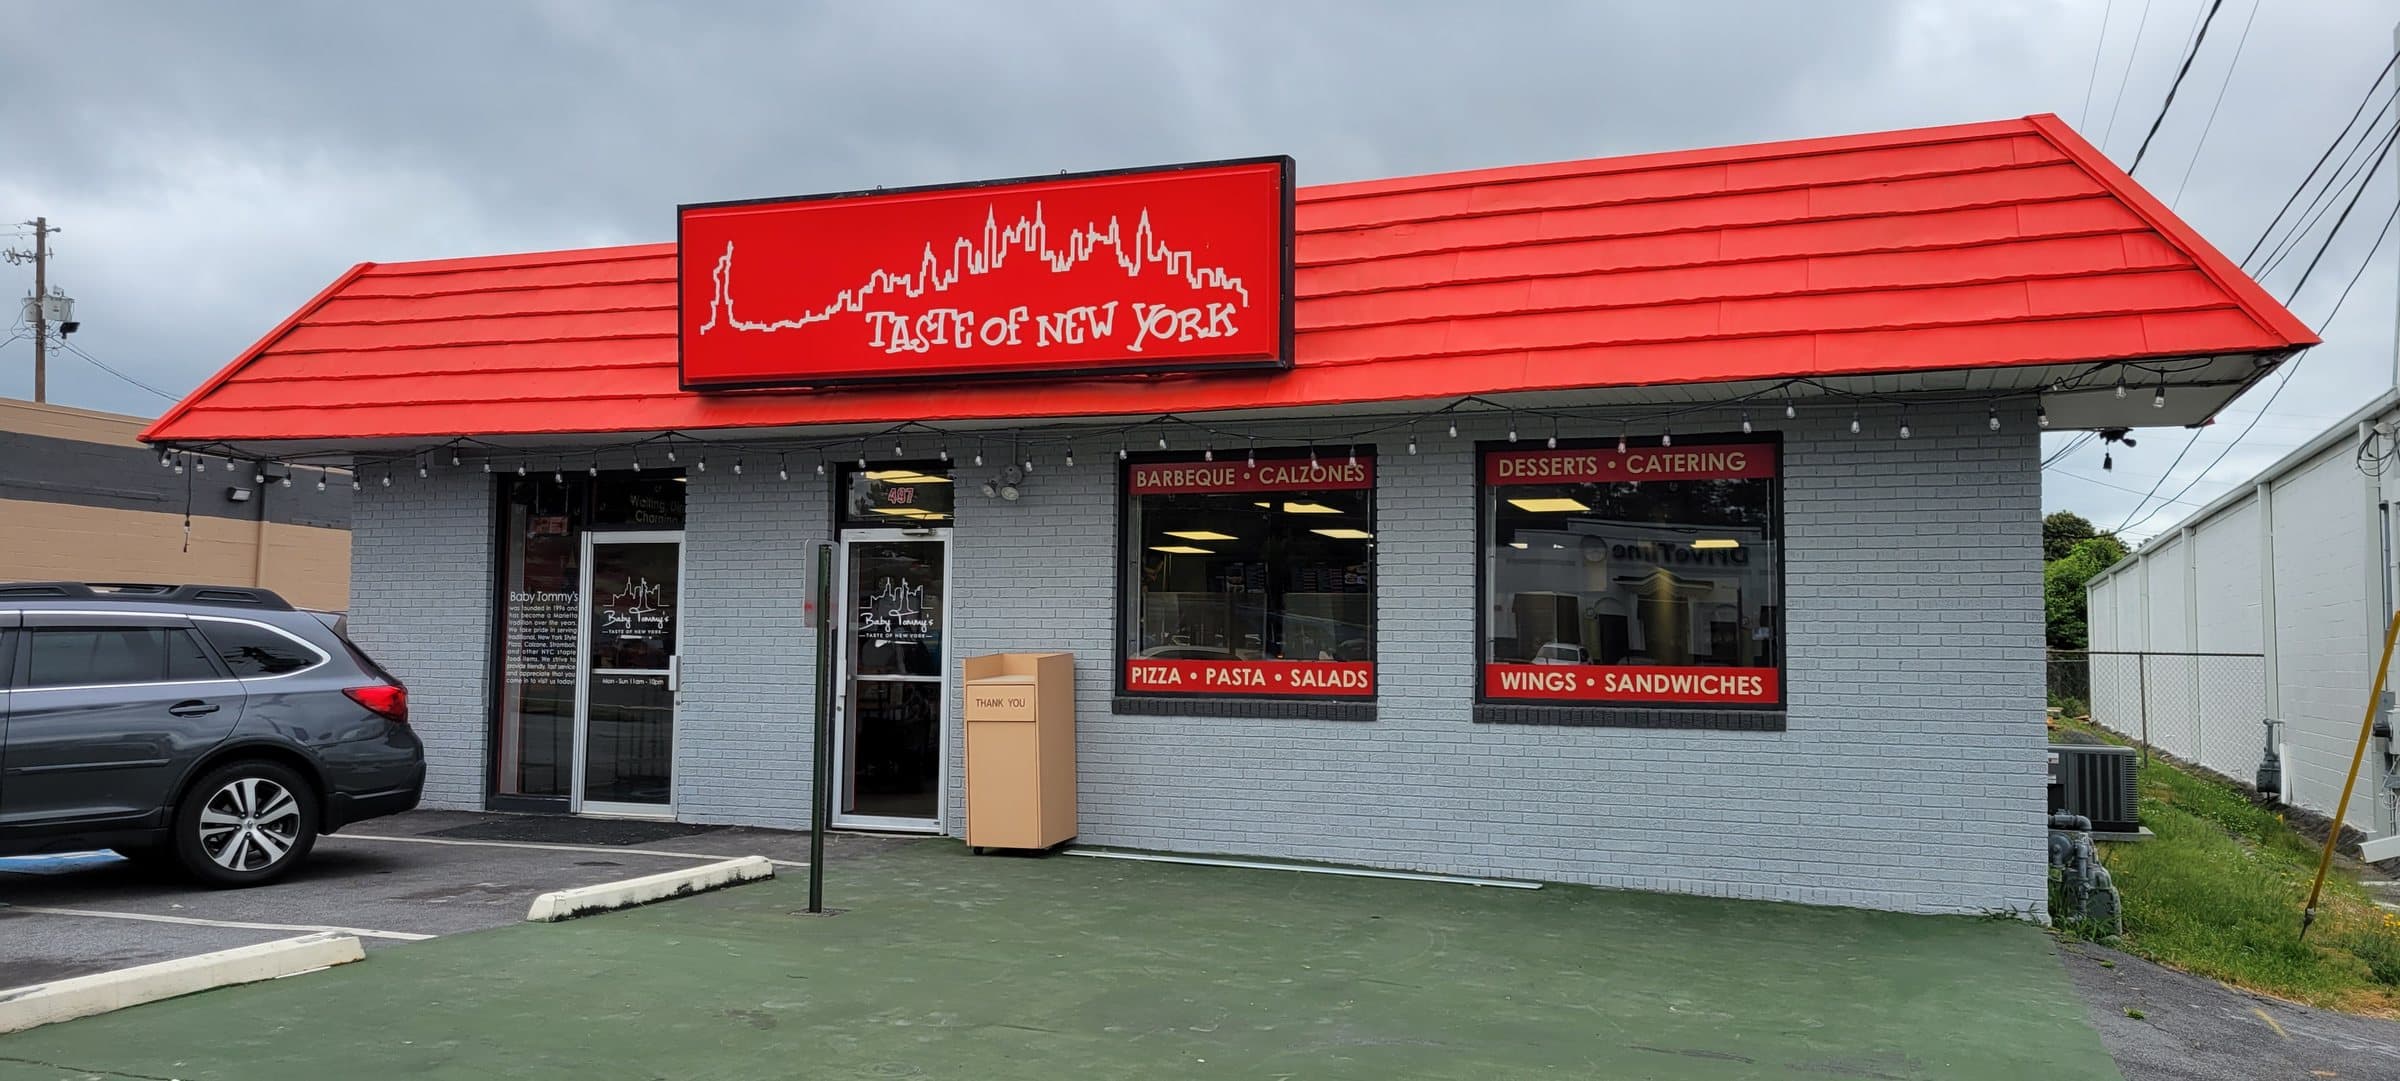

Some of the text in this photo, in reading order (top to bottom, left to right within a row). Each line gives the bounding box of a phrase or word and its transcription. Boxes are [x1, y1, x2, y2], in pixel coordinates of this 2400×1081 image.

[865, 308, 974, 353] TASTE
[1036, 301, 1120, 347] NEW
[1126, 302, 1239, 352] YORK
[1136, 464, 1365, 487] BARBEQUE CALZONES
[1500, 452, 1747, 477] DESSERTS CATERING
[510, 591, 579, 604] Baby Tommy's
[602, 607, 669, 629] Baby Tommy's
[859, 610, 934, 632] Baby Tommy's
[1131, 667, 1368, 688] PIZZA PASTA SALADS
[1500, 672, 1763, 695] WINGS SANDWICHES
[976, 698, 1026, 708] THANK YOU
